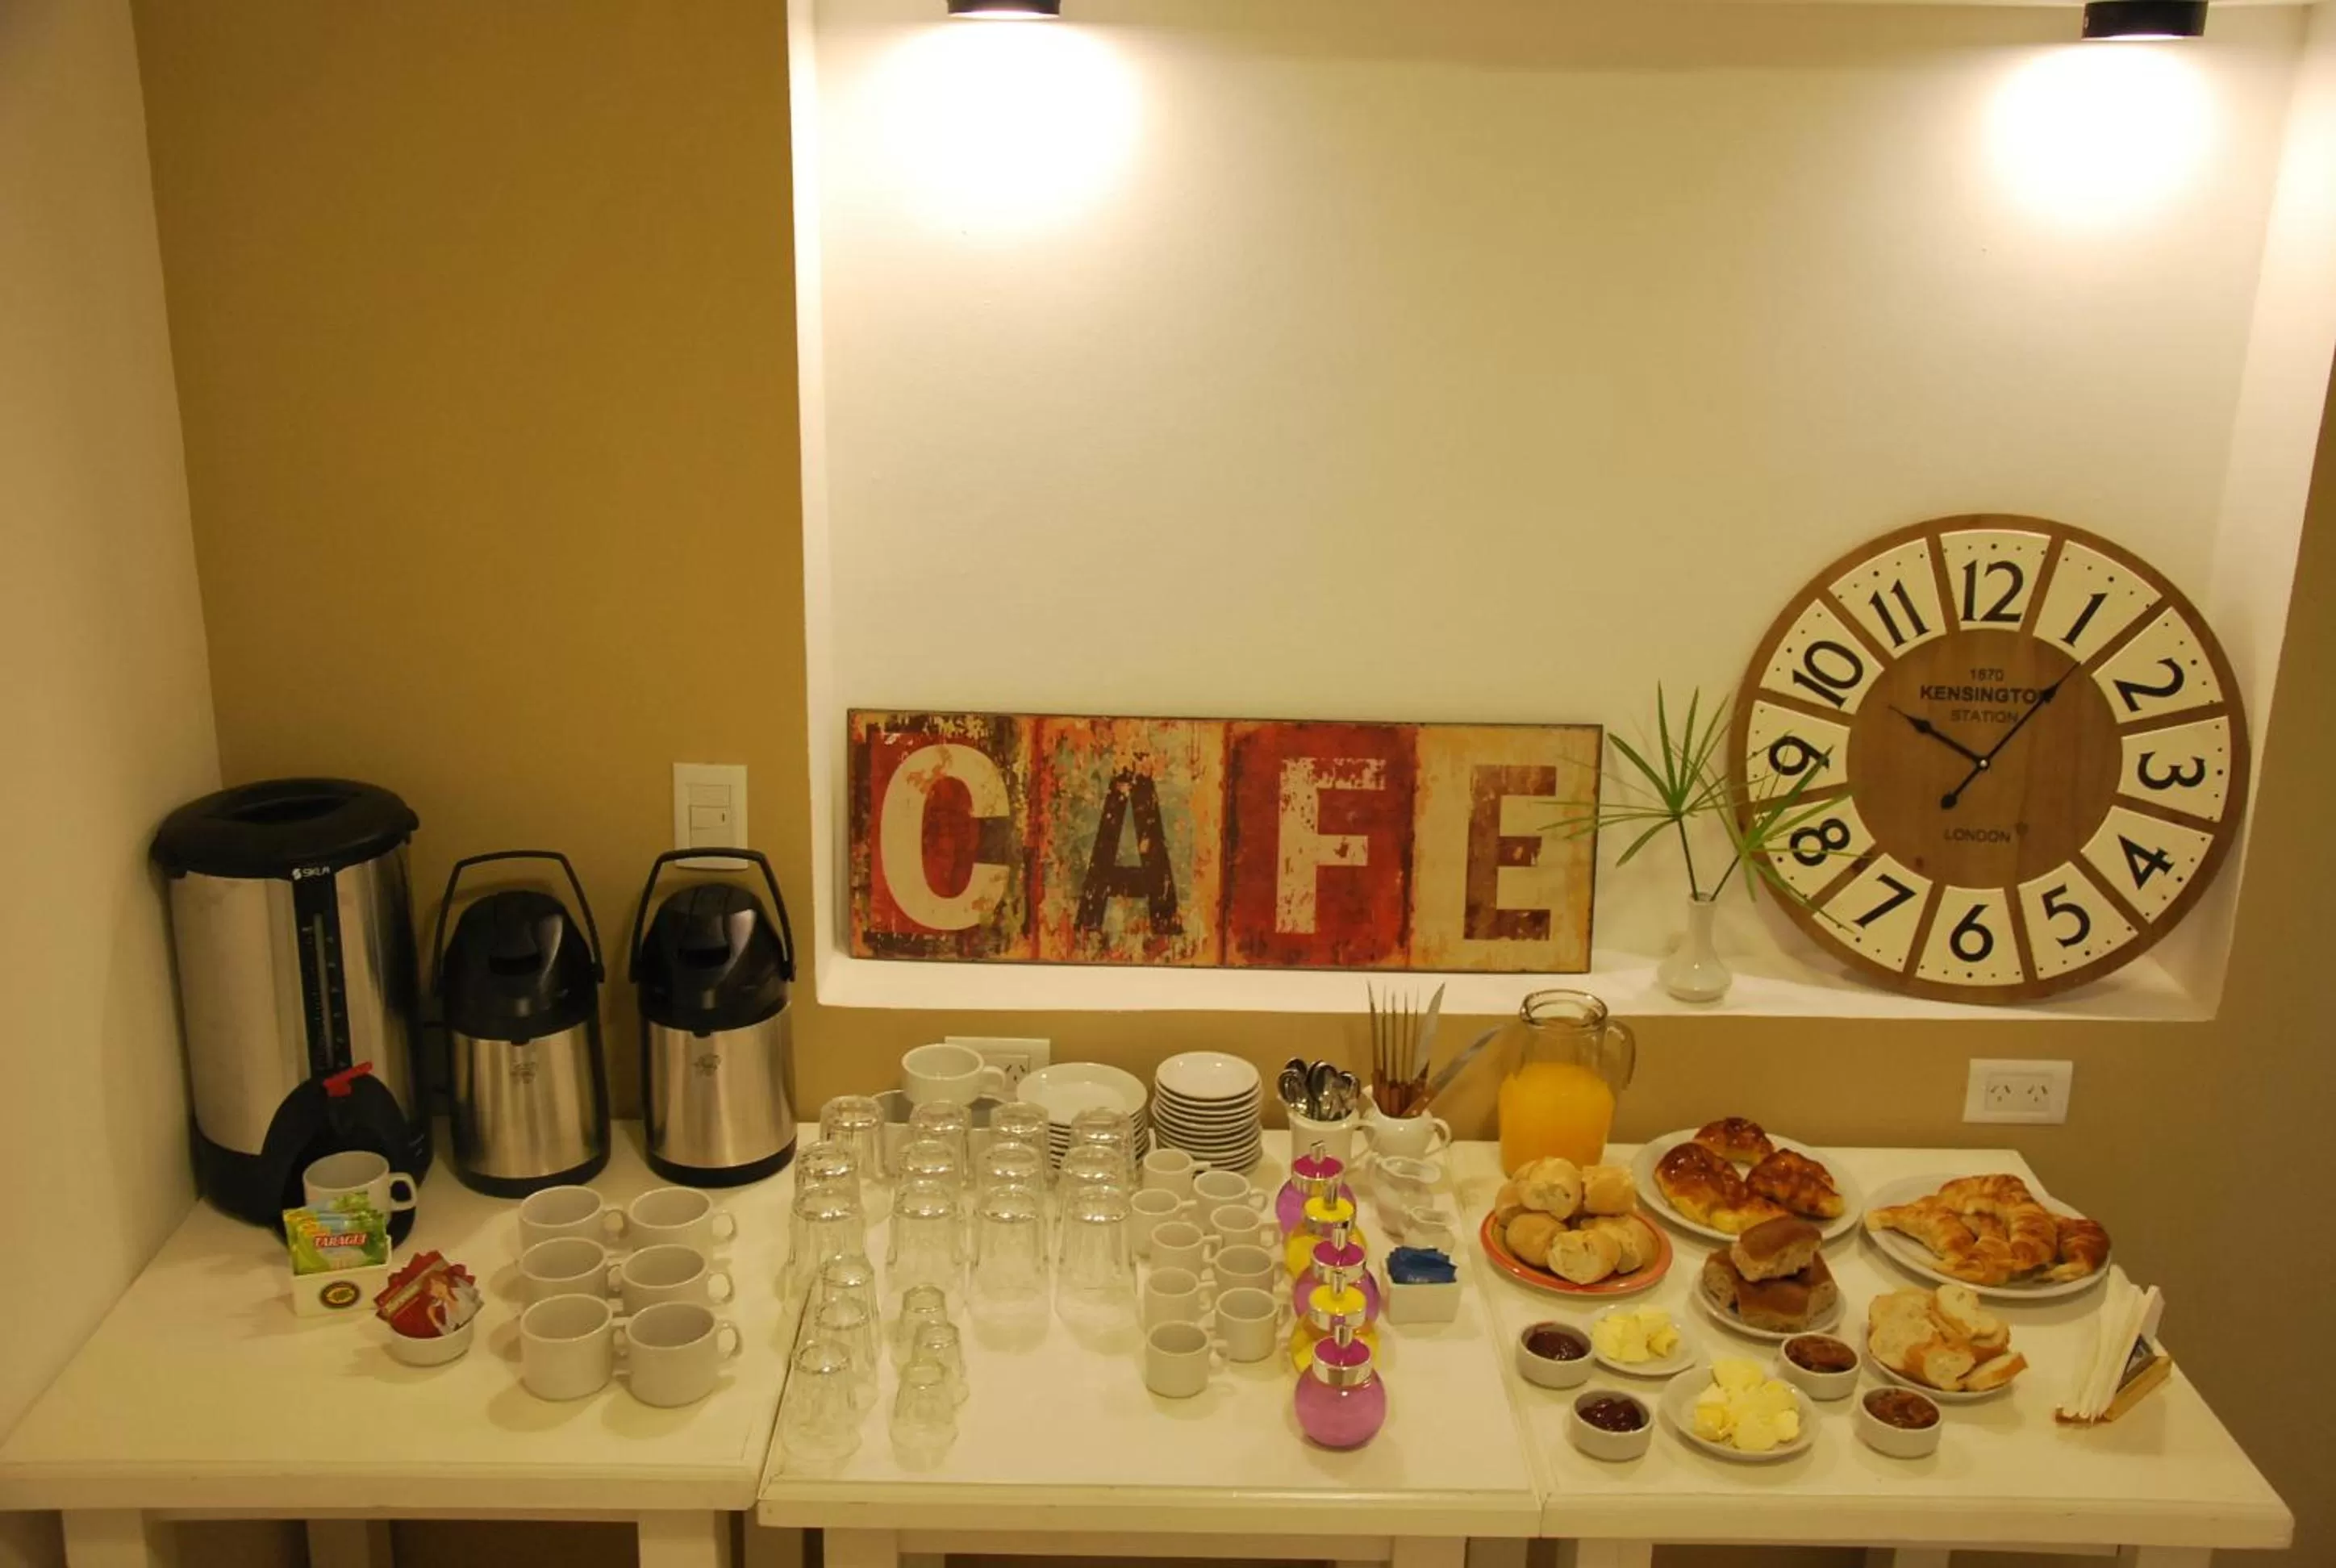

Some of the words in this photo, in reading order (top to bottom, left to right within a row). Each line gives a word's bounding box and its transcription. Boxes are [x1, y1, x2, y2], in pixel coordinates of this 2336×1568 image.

[1961, 559, 2025, 623] 12
[1920, 685, 2050, 705] KENSINGTO
[2113, 657, 2185, 712] 2
[1950, 709, 2019, 724] STATION
[2137, 750, 2206, 790] 3
[879, 742, 1558, 941] CAFE
[1788, 817, 1851, 867] 8
[1944, 827, 2012, 844] LONDON
[2117, 833, 2175, 890] 4
[1852, 873, 1917, 929] 7
[2041, 882, 2092, 949] 5
[1949, 903, 1994, 962] 6
